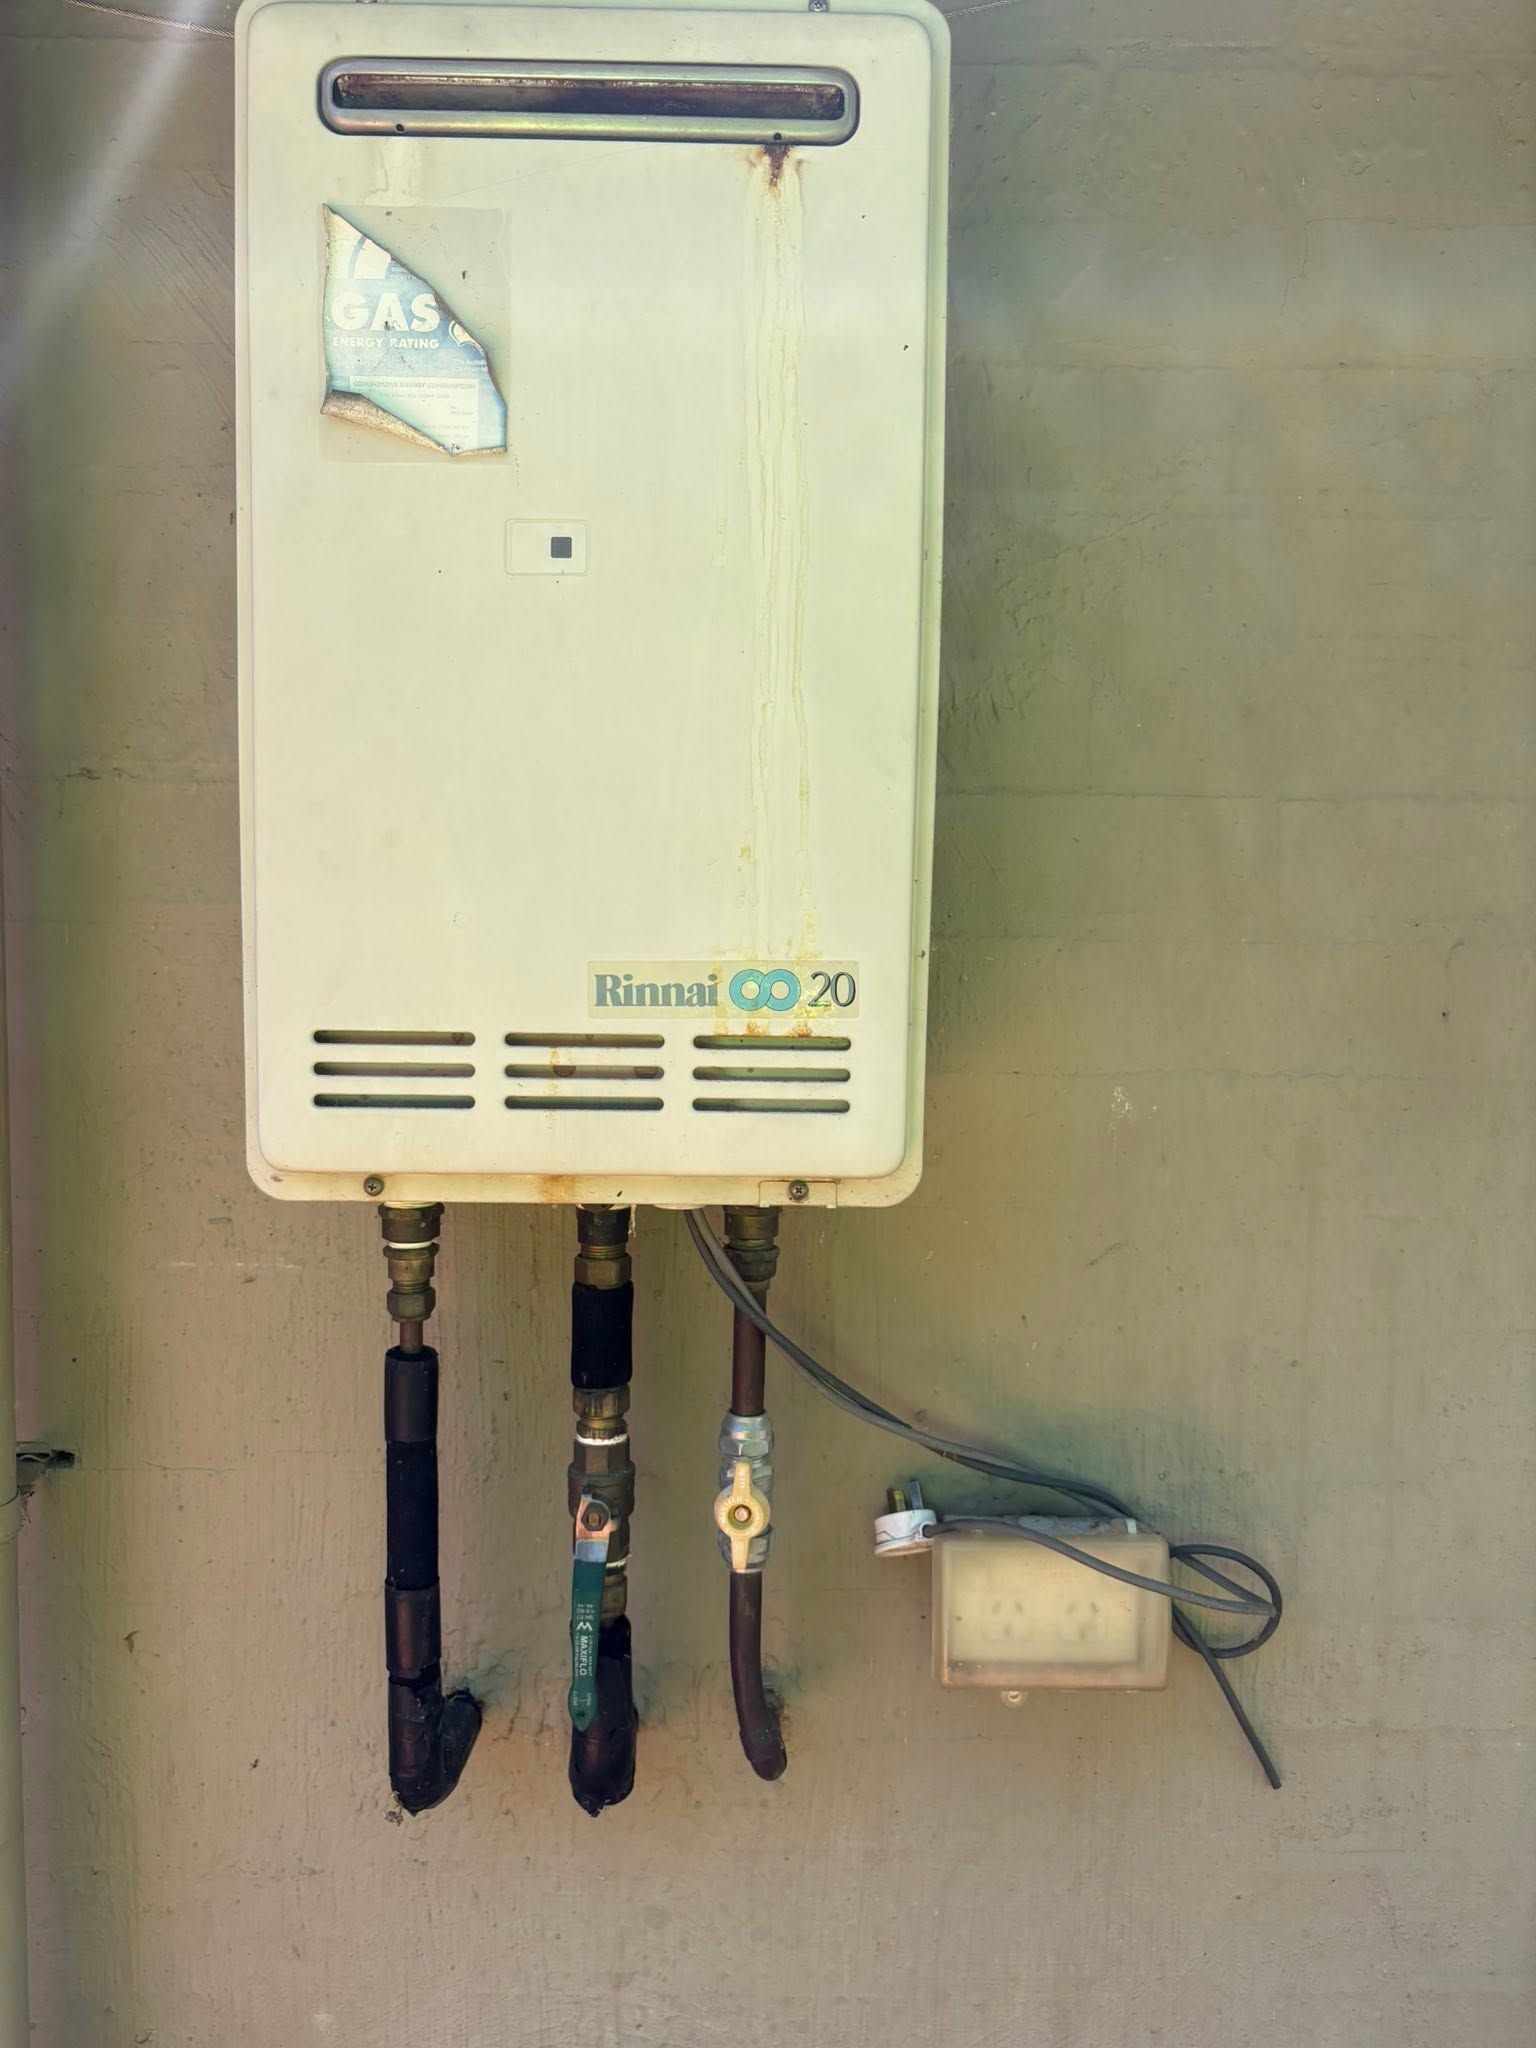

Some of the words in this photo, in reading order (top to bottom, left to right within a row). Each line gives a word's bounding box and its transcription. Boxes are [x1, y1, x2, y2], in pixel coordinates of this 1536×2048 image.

[332, 293, 440, 332] GAS
[332, 336, 383, 348] ENERGY
[389, 337, 440, 349] RATING
[594, 973, 719, 1007] Rinnai
[808, 971, 856, 1008] 20
[579, 1635, 588, 1676] MAXIFLO
